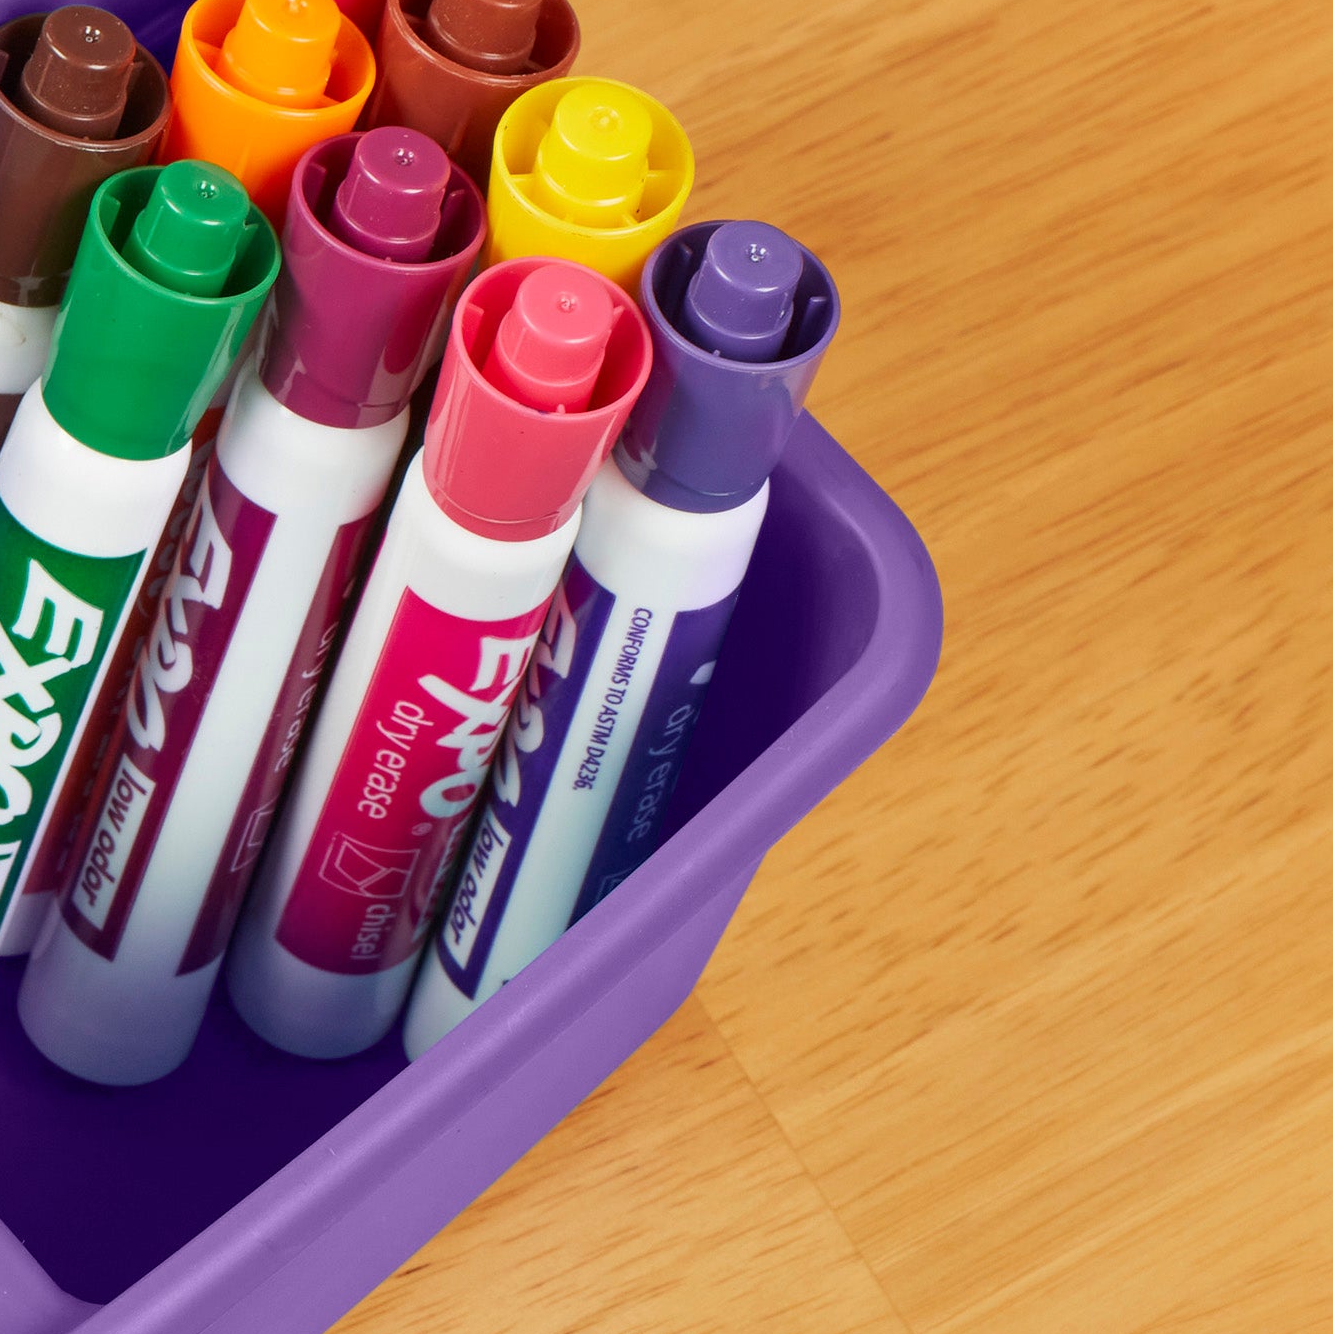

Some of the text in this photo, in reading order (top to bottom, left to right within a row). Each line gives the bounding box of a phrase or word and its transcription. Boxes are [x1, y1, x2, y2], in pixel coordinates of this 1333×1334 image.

[357, 700, 434, 820] dry erase
[572, 607, 653, 791] CONFORMS TO ASTM D4236.
[81, 767, 148, 907] low odor
[626, 703, 697, 843] dry erase
[350, 903, 397, 961] chisel
[450, 819, 505, 945] low odor
